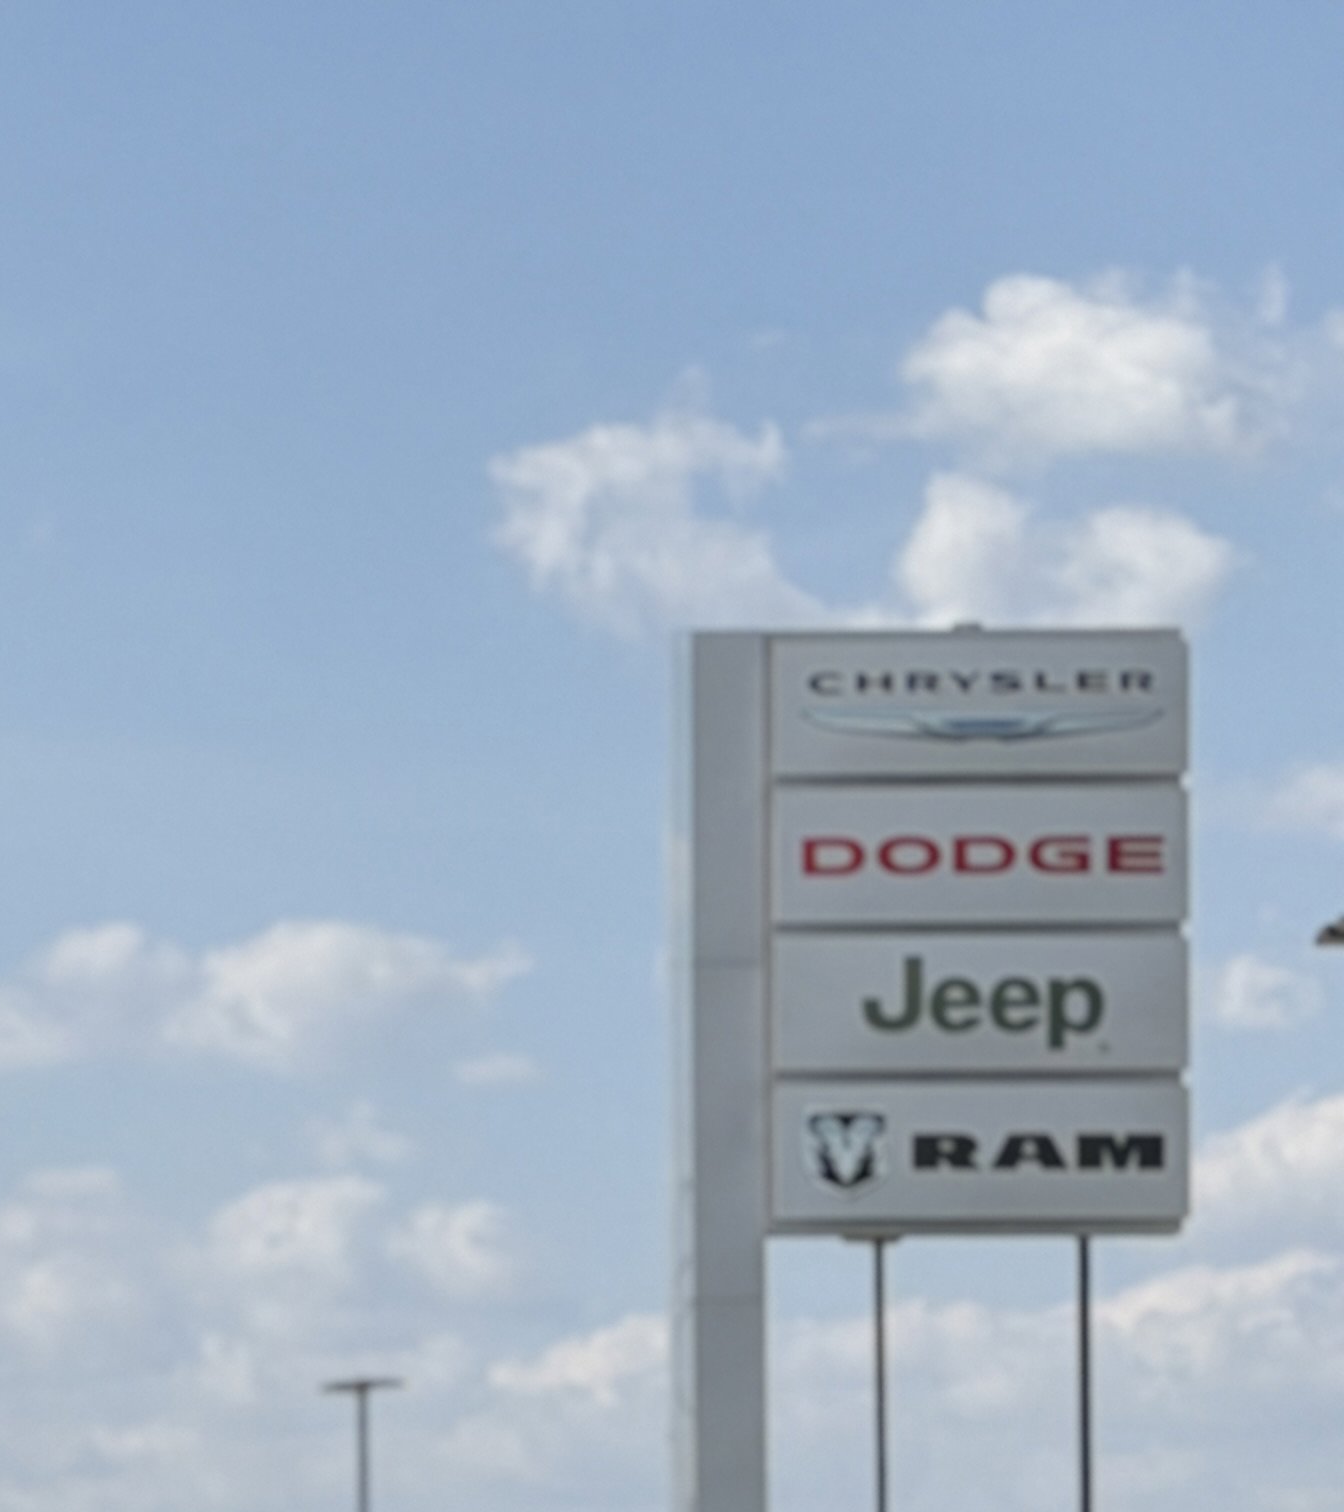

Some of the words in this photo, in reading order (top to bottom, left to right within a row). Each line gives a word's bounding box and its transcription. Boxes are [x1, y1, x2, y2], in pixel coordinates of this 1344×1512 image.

[807, 669, 1155, 694] CHRYSLER
[801, 836, 1166, 877] DODGE
[862, 956, 1104, 1050] Jeep
[911, 1132, 1166, 1170] RAM
